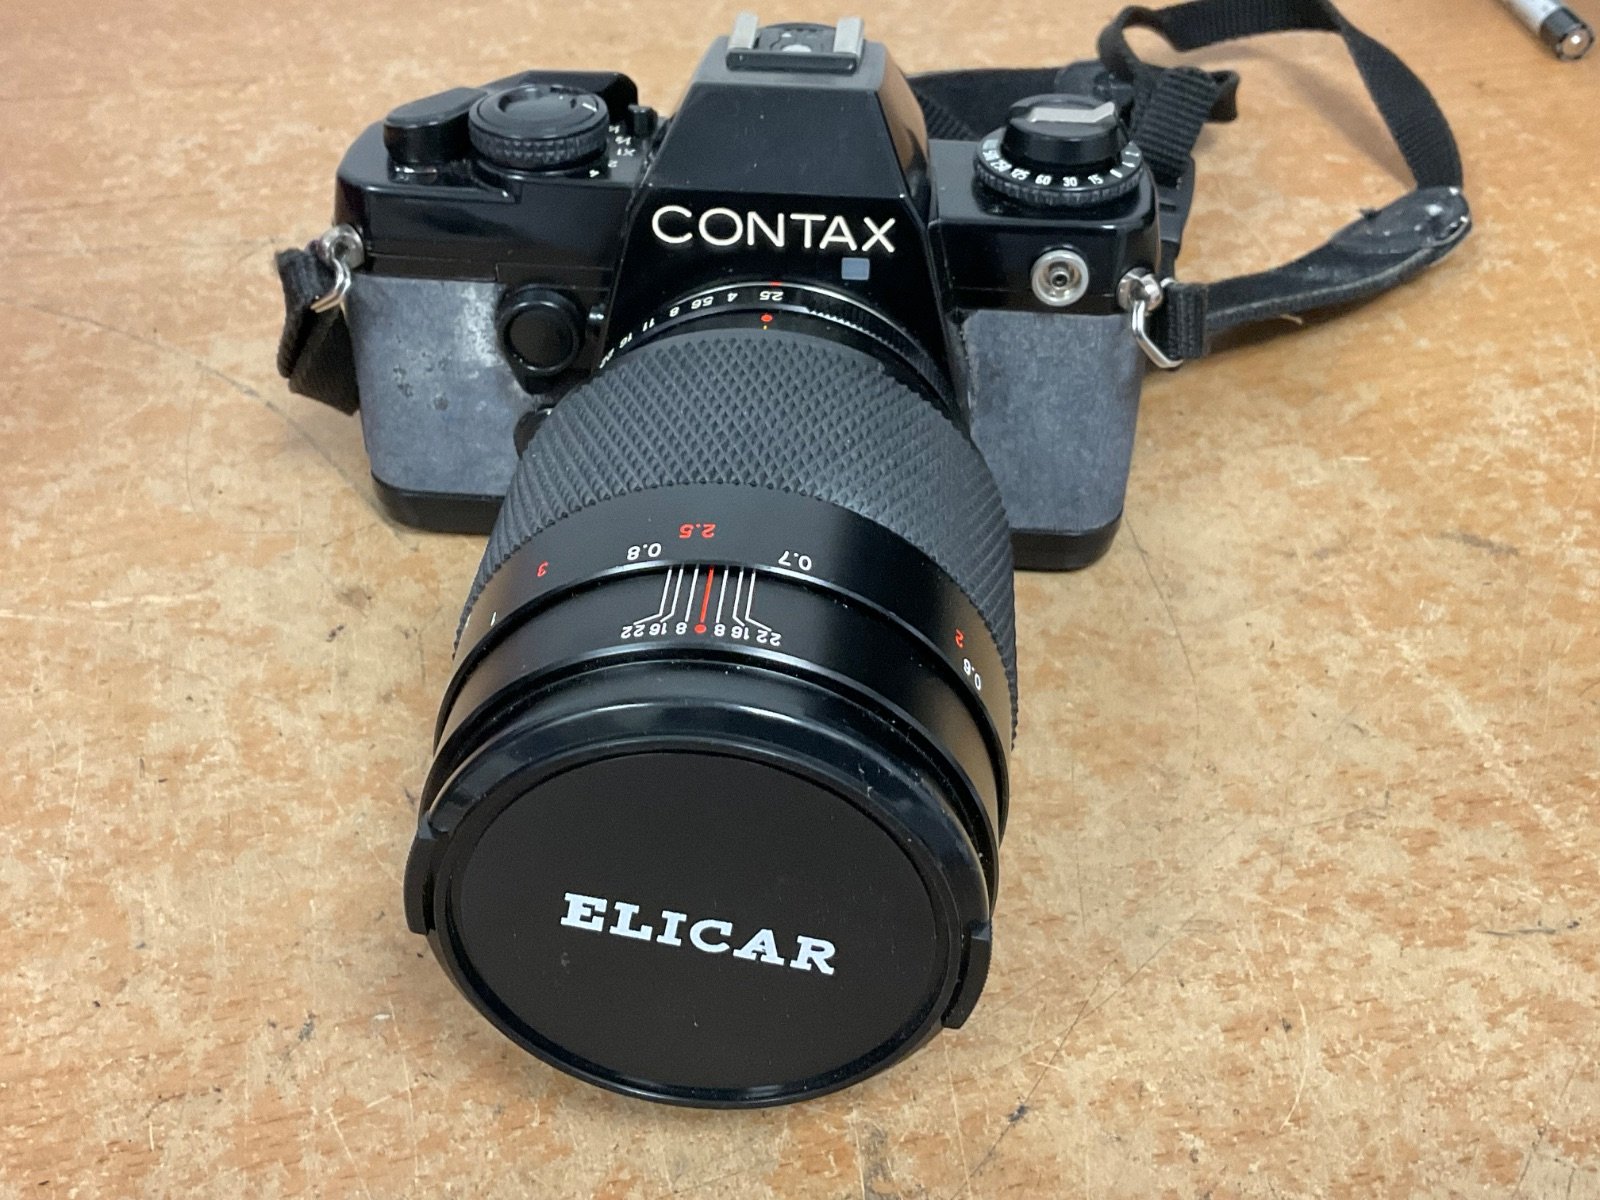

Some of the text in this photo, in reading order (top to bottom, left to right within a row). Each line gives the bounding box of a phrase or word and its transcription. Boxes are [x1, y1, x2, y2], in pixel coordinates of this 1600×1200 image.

[1035, 174, 1052, 186] 60
[1062, 176, 1078, 187] 30
[1088, 174, 1104, 185] 15
[651, 205, 896, 253] CONTAX
[727, 292, 738, 303] 4
[669, 306, 680, 317] 8
[642, 318, 655, 332] 11
[626, 543, 661, 561] 0.8
[778, 551, 813, 571] 0.7
[536, 523, 965, 648] 2 2.5 3
[620, 622, 782, 647] 22 16 8 8 16 22
[963, 658, 983, 691] 0.6
[560, 892, 836, 976] ELICAR
